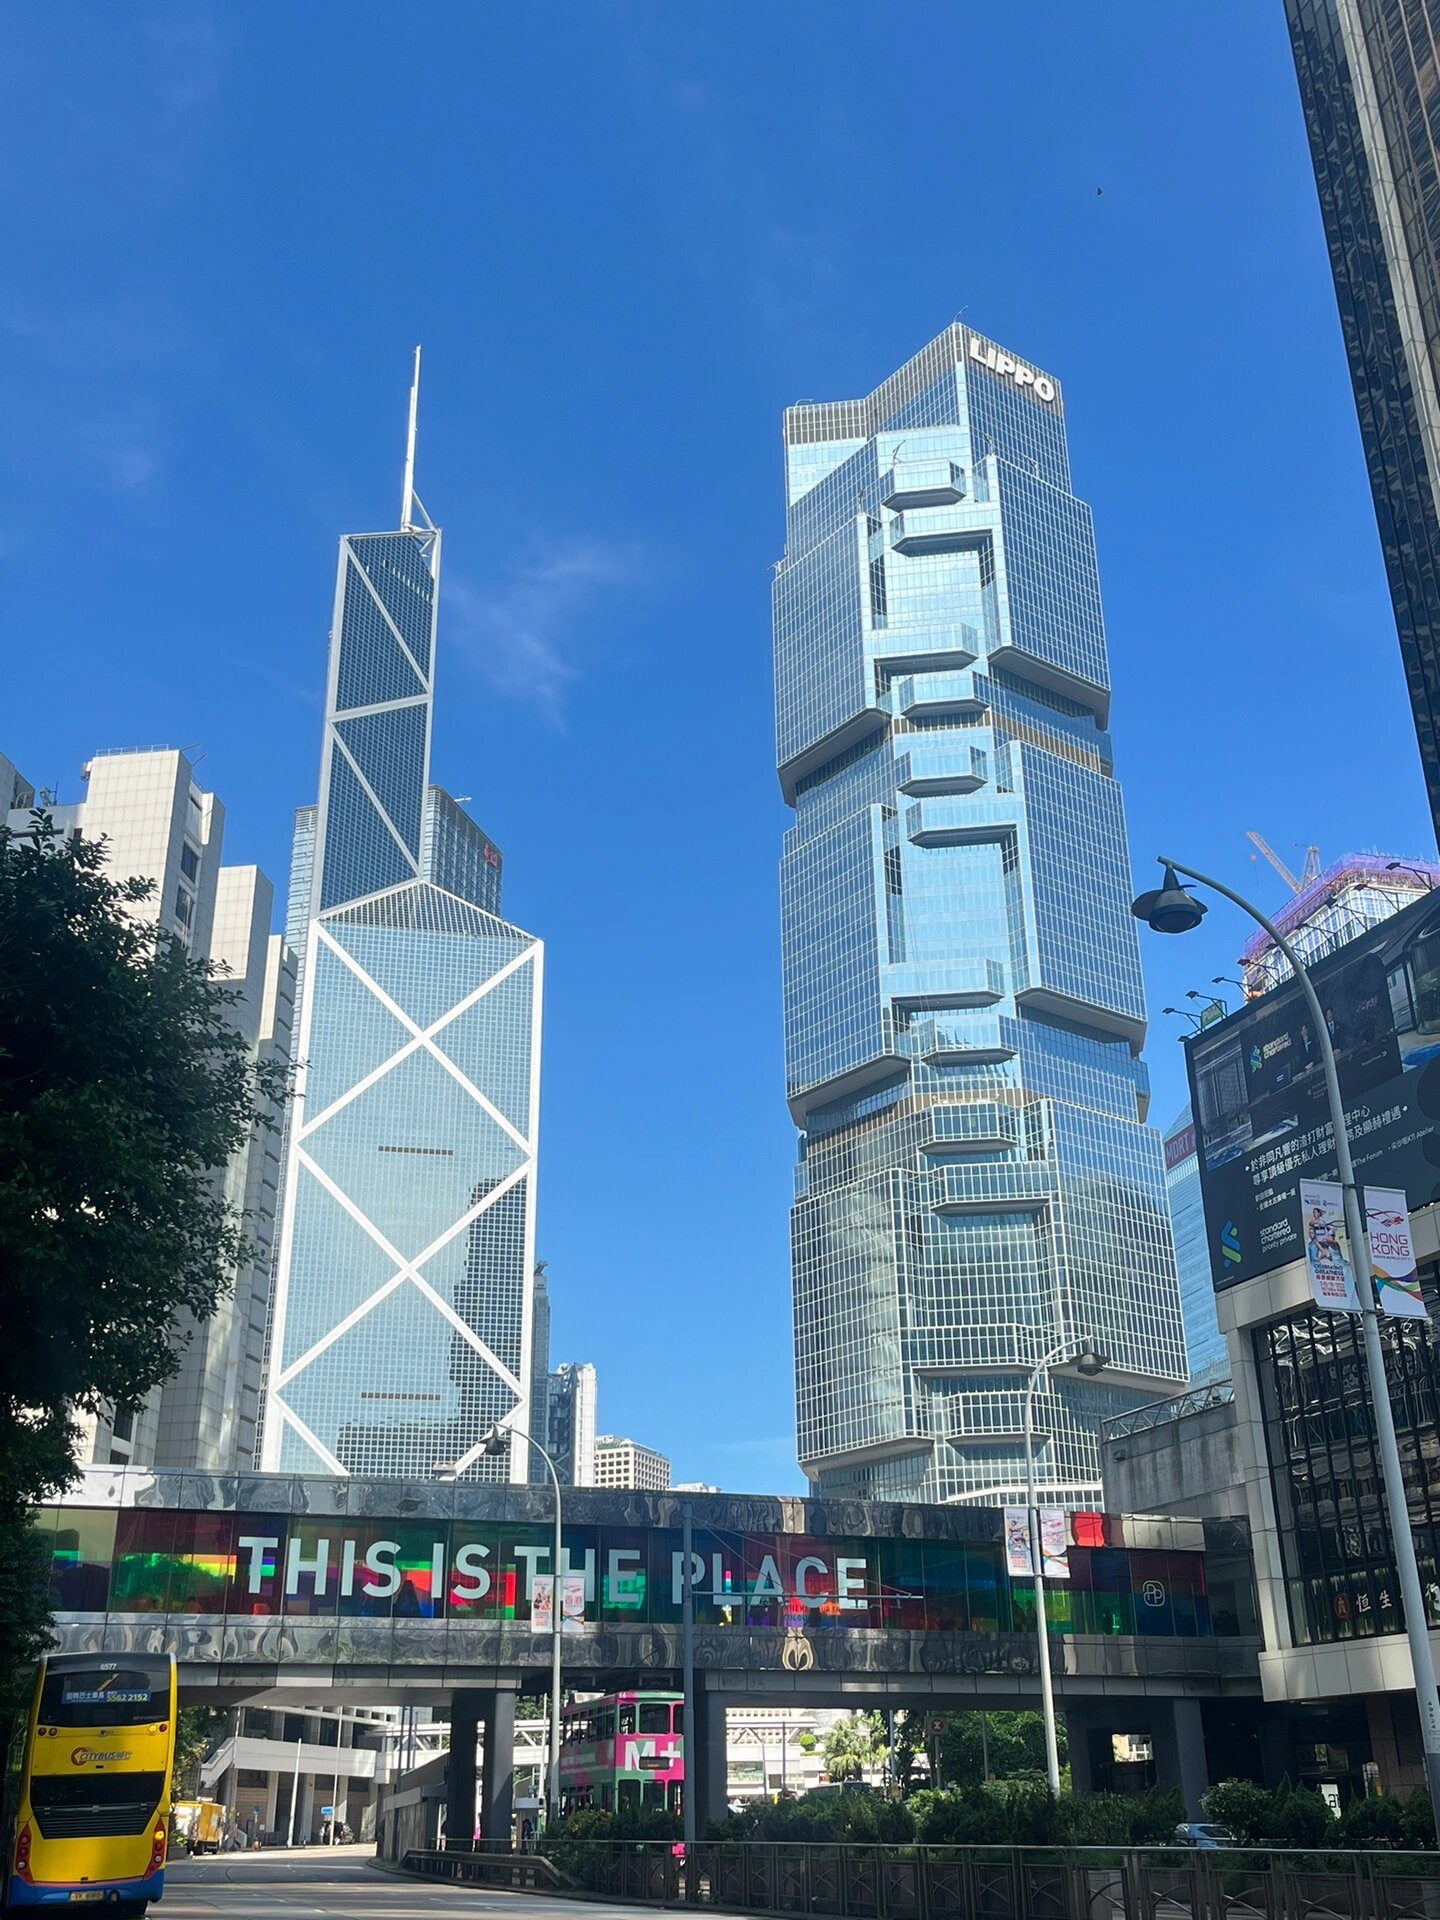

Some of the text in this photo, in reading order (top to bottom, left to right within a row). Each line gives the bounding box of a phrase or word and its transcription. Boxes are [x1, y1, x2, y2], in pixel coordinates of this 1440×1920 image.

[969, 337, 1056, 402] LIPPO
[1250, 1105, 1371, 1173] 於非同凡響的渣打財富理中心
[1260, 1218, 1288, 1237] standard
[1261, 1226, 1291, 1244] chartered
[1370, 1232, 1408, 1245] HONG
[1371, 1244, 1410, 1257] KONG
[238, 1536, 868, 1610] THIS IS THE PLACE
[100, 1663, 117, 1671] 6577
[127, 1693, 148, 1702] 2152
[624, 1741, 681, 1771] M+
